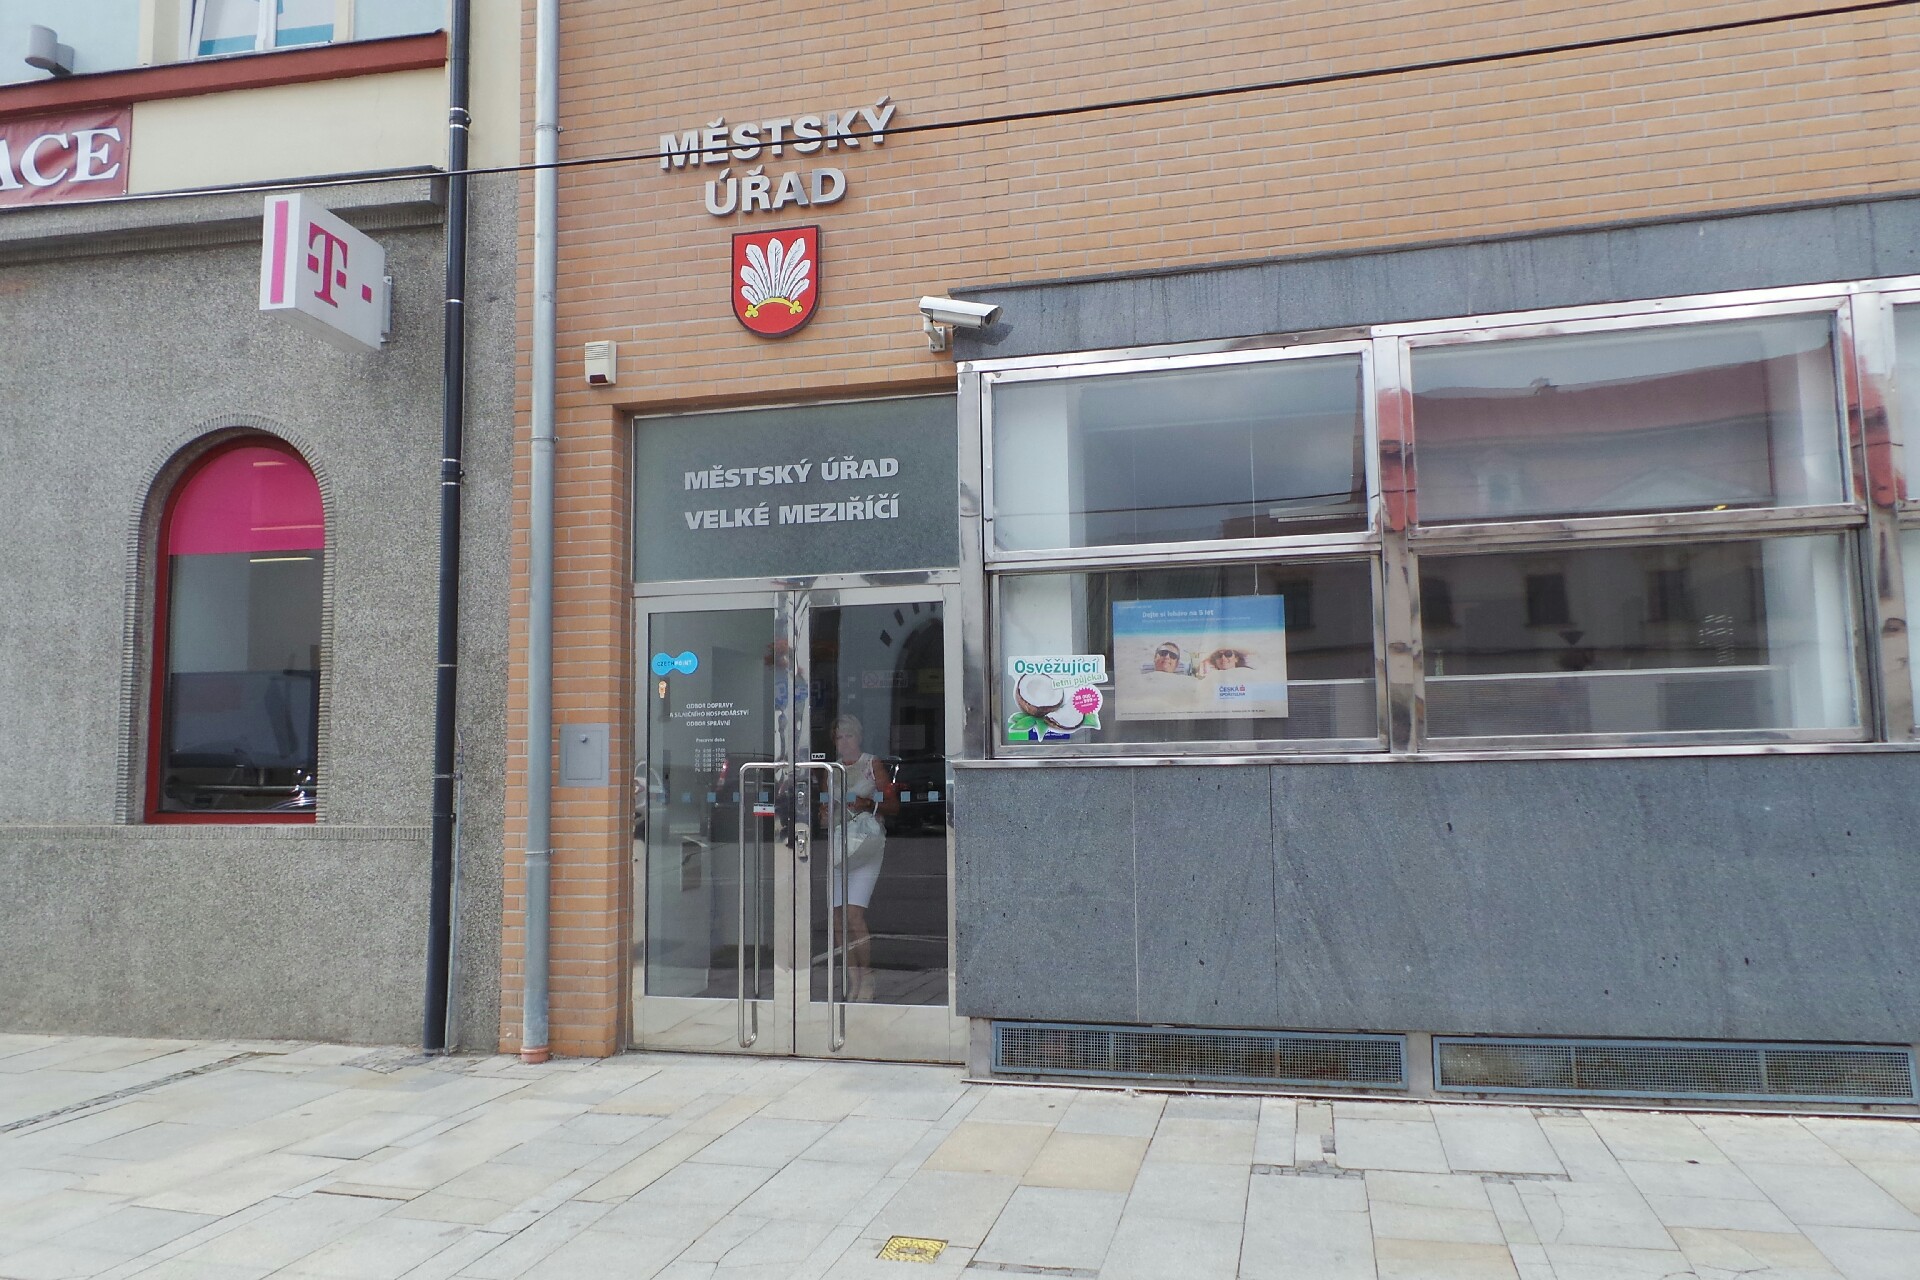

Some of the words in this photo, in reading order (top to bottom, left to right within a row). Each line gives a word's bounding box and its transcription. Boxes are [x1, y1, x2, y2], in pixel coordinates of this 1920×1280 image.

[660, 95, 896, 171] MĚSTSKÝ
[705, 164, 847, 218] ÚŘAD
[684, 458, 813, 490] MĚSTSKÝ
[821, 455, 899, 481] ÚŘAD
[684, 501, 770, 530] VELKÉ
[778, 493, 900, 524] MEZIŘÍČÍ
[1014, 658, 1097, 676] Osvěžující
[1052, 678, 1072, 688] letní
